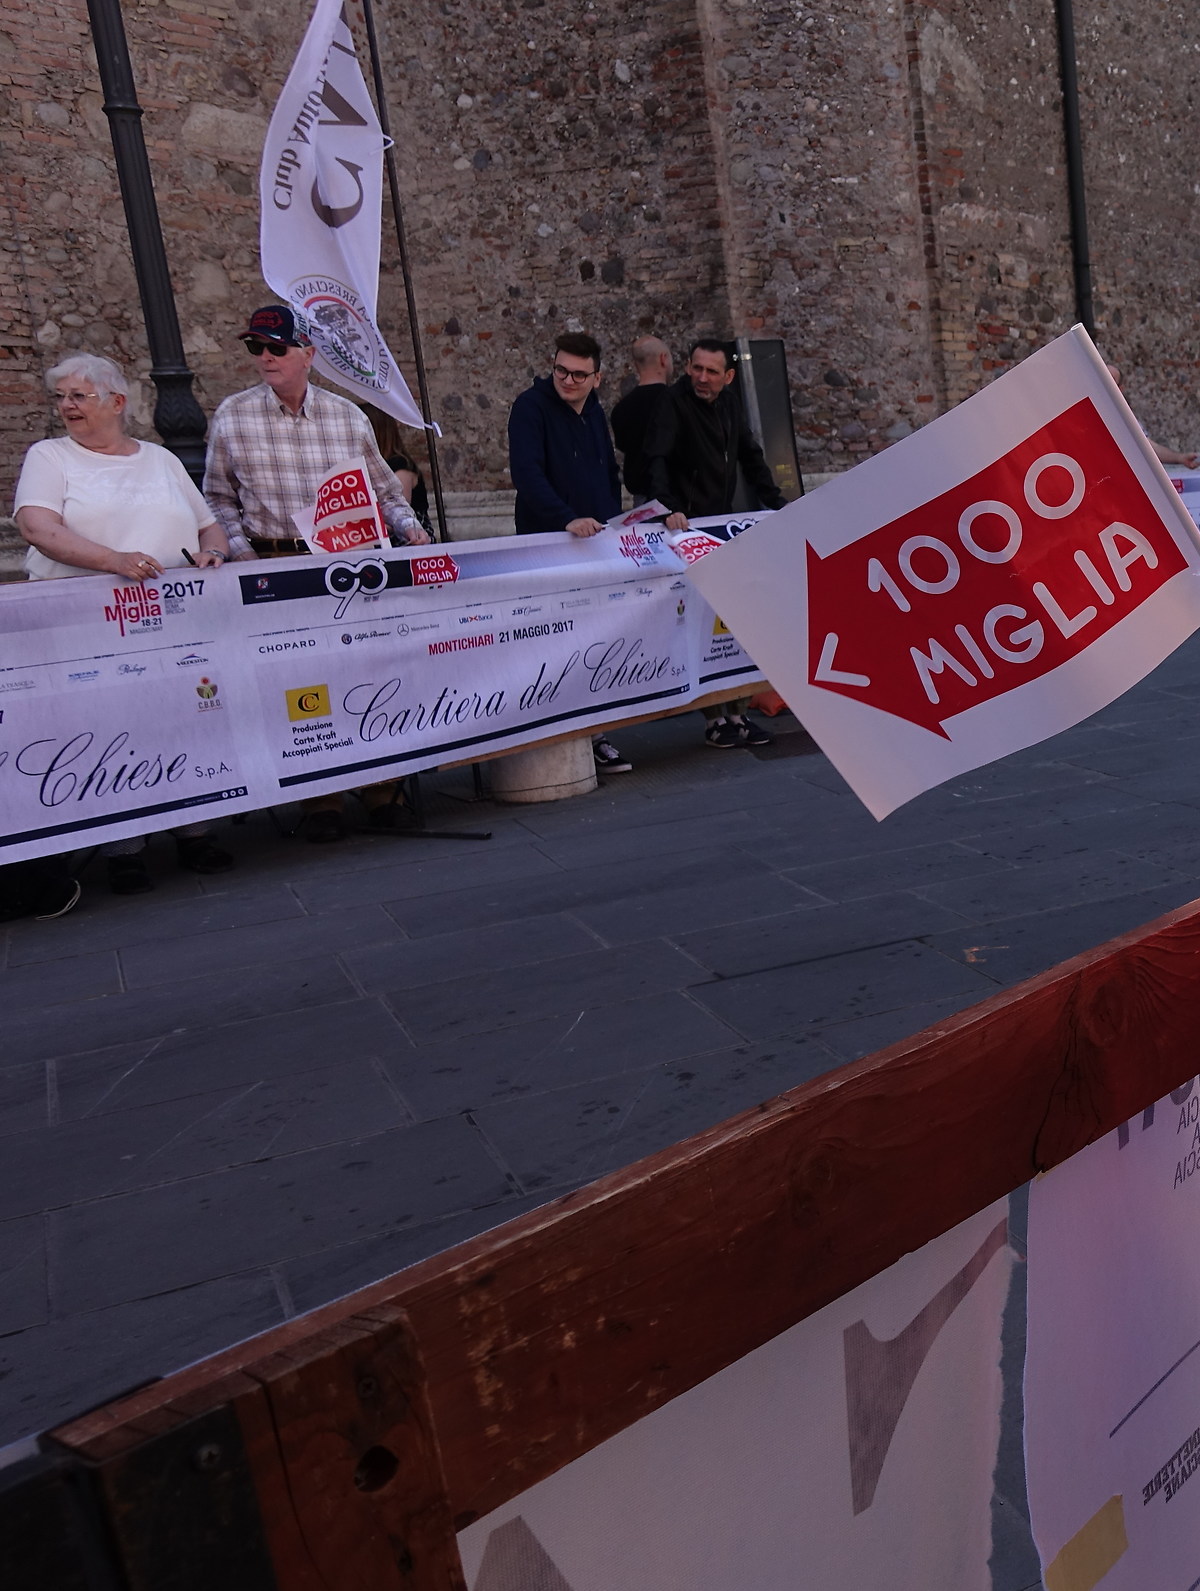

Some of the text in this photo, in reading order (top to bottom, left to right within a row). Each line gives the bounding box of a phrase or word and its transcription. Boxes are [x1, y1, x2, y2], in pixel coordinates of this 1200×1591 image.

[316, 490, 368, 520] MIGLIA
[331, 524, 377, 551] MIGLI
[620, 526, 646, 548] Mille
[867, 452, 1086, 612] 1000
[416, 557, 445, 570] 1000
[619, 546, 652, 567] Miglia
[416, 570, 453, 583] MIGLIA
[113, 579, 205, 605] Mille 2017
[104, 602, 162, 637] Miglia
[909, 521, 1159, 704] MIGLIA
[258, 639, 317, 654] CHOPARD
[428, 620, 574, 656] MONTICHIARI 21 MAGGIO 2017
[343, 678, 507, 742] Cartiera
[519, 650, 580, 711] del
[584, 637, 670, 692] Chiese
[292, 721, 333, 734] Produzione
[293, 731, 337, 746] Carte Kraft
[282, 737, 354, 759] Accoppiati Speciali
[15, 731, 233, 807] Chiese S.p.A.
